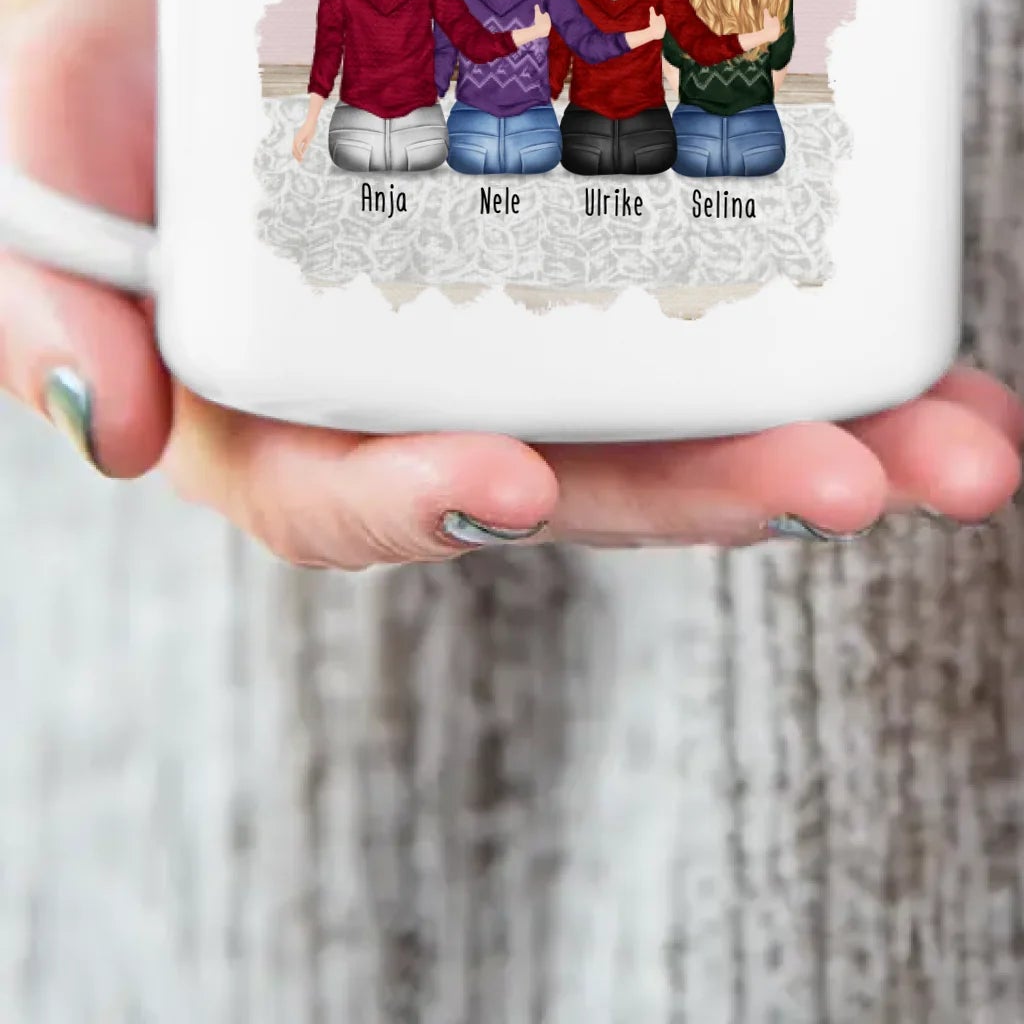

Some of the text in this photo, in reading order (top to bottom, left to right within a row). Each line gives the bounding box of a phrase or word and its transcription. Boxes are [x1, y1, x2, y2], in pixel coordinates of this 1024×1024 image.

[361, 182, 408, 219] Anja
[480, 186, 521, 215] Nele
[585, 187, 644, 217] Ulrike
[692, 188, 756, 219] Selina
